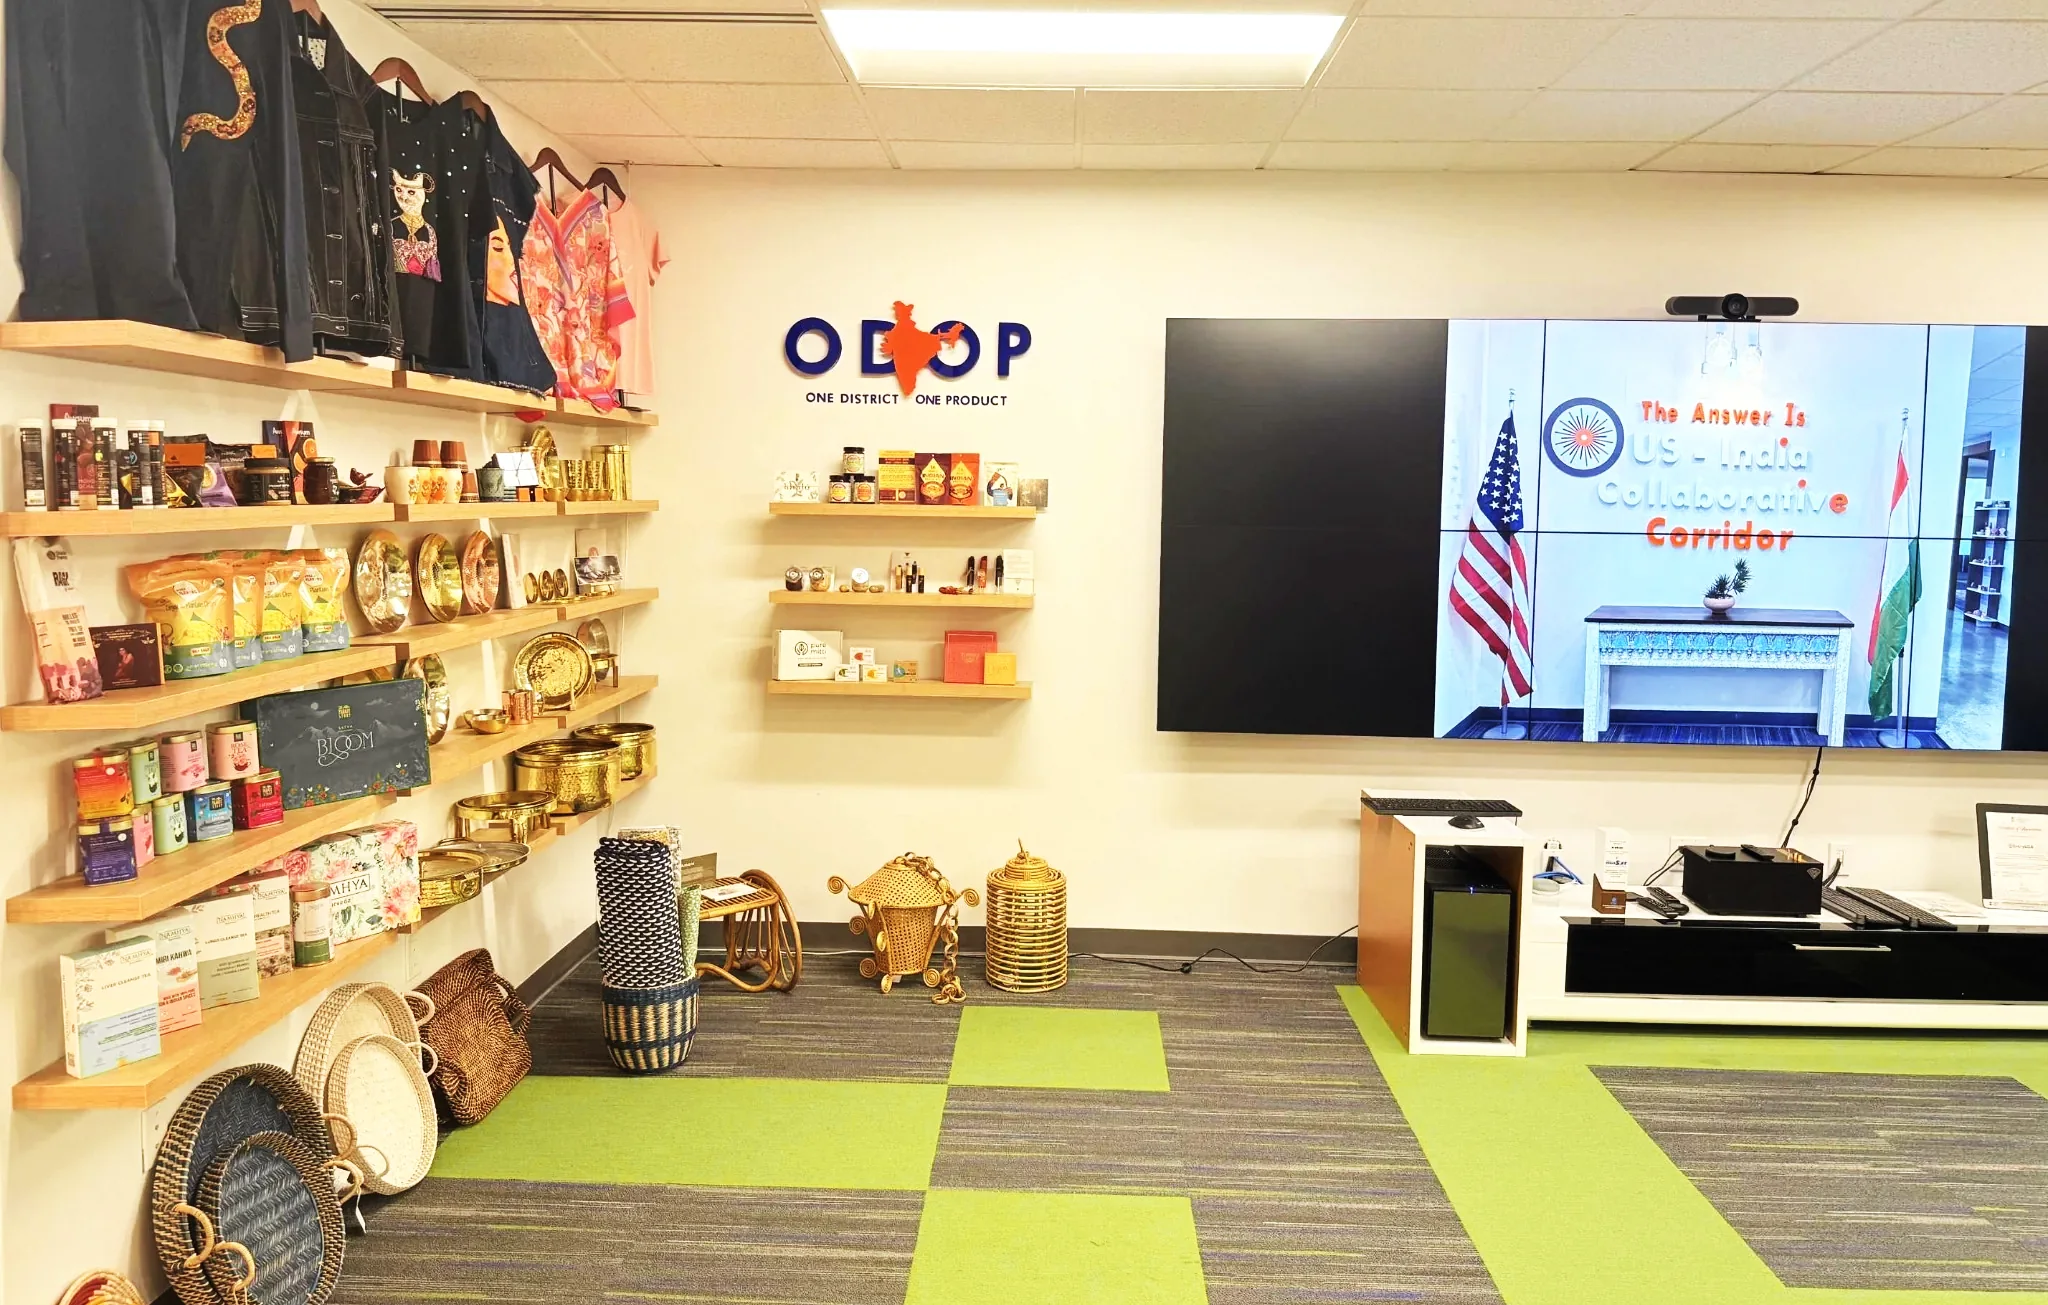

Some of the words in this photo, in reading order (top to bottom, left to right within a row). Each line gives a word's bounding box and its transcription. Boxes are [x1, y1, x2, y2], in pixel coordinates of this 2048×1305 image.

[805, 392, 834, 404] ONE
[840, 393, 899, 405] DISTRICT
[915, 394, 941, 406] ONE
[945, 395, 1008, 407] PRODUCT
[1641, 400, 1679, 424] The
[1691, 402, 1772, 426] Answer
[1784, 402, 1806, 427] Is
[1632, 433, 1680, 465] US
[1720, 436, 1810, 470] India
[1596, 478, 1849, 515] Collaborative
[1646, 516, 1795, 553] Corridor
[317, 731, 374, 767] BLOOM
[330, 879, 369, 897] MHYA
[170, 948, 192, 961] KAHWA
